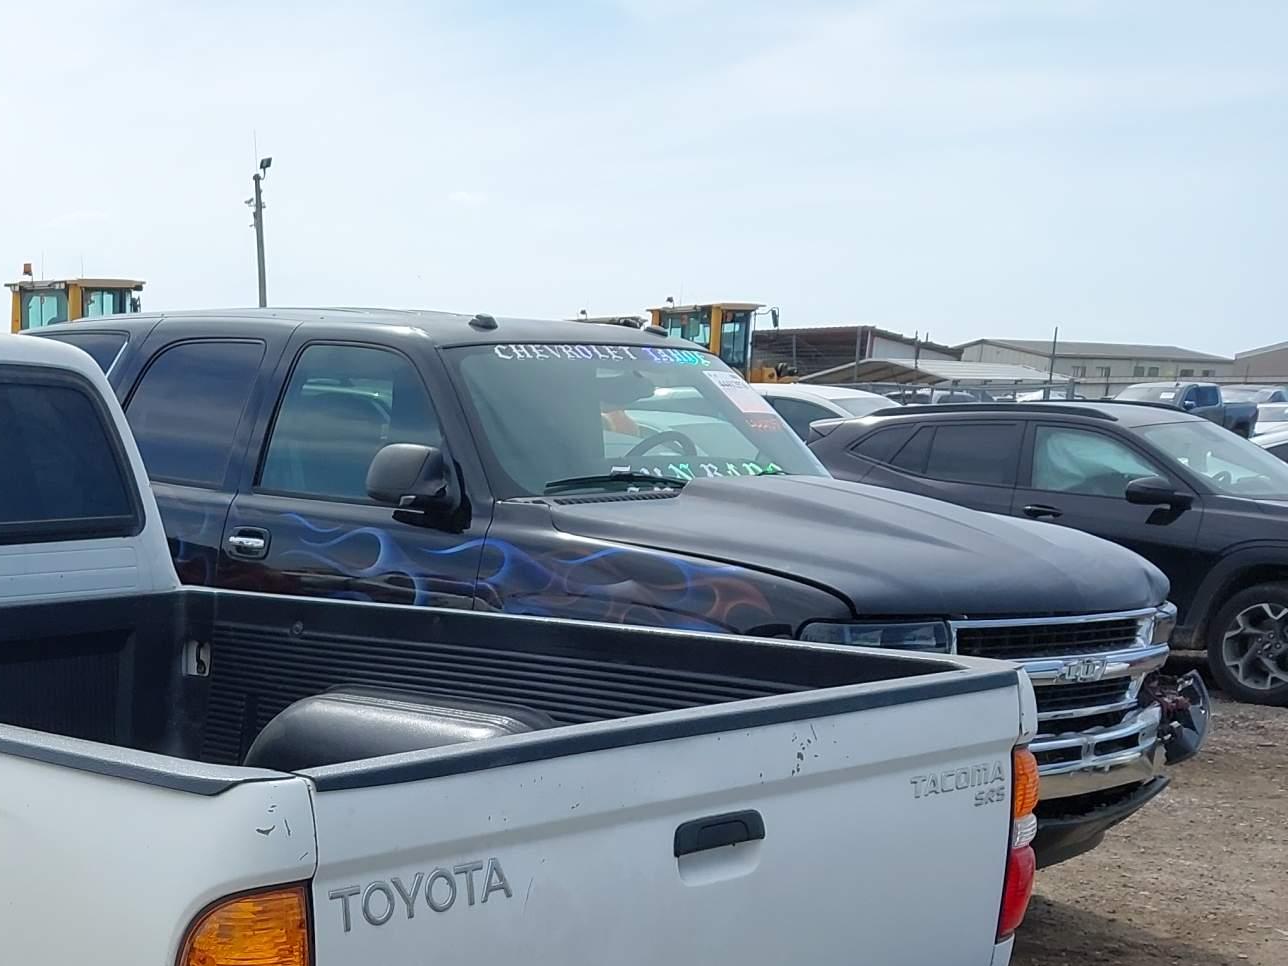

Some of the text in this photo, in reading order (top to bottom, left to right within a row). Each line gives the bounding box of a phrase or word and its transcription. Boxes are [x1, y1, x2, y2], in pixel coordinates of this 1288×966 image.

[494, 344, 711, 367] CHEVROLET TAHOE
[910, 761, 1005, 799] TACOMA
[328, 857, 513, 933] TOYOTA
